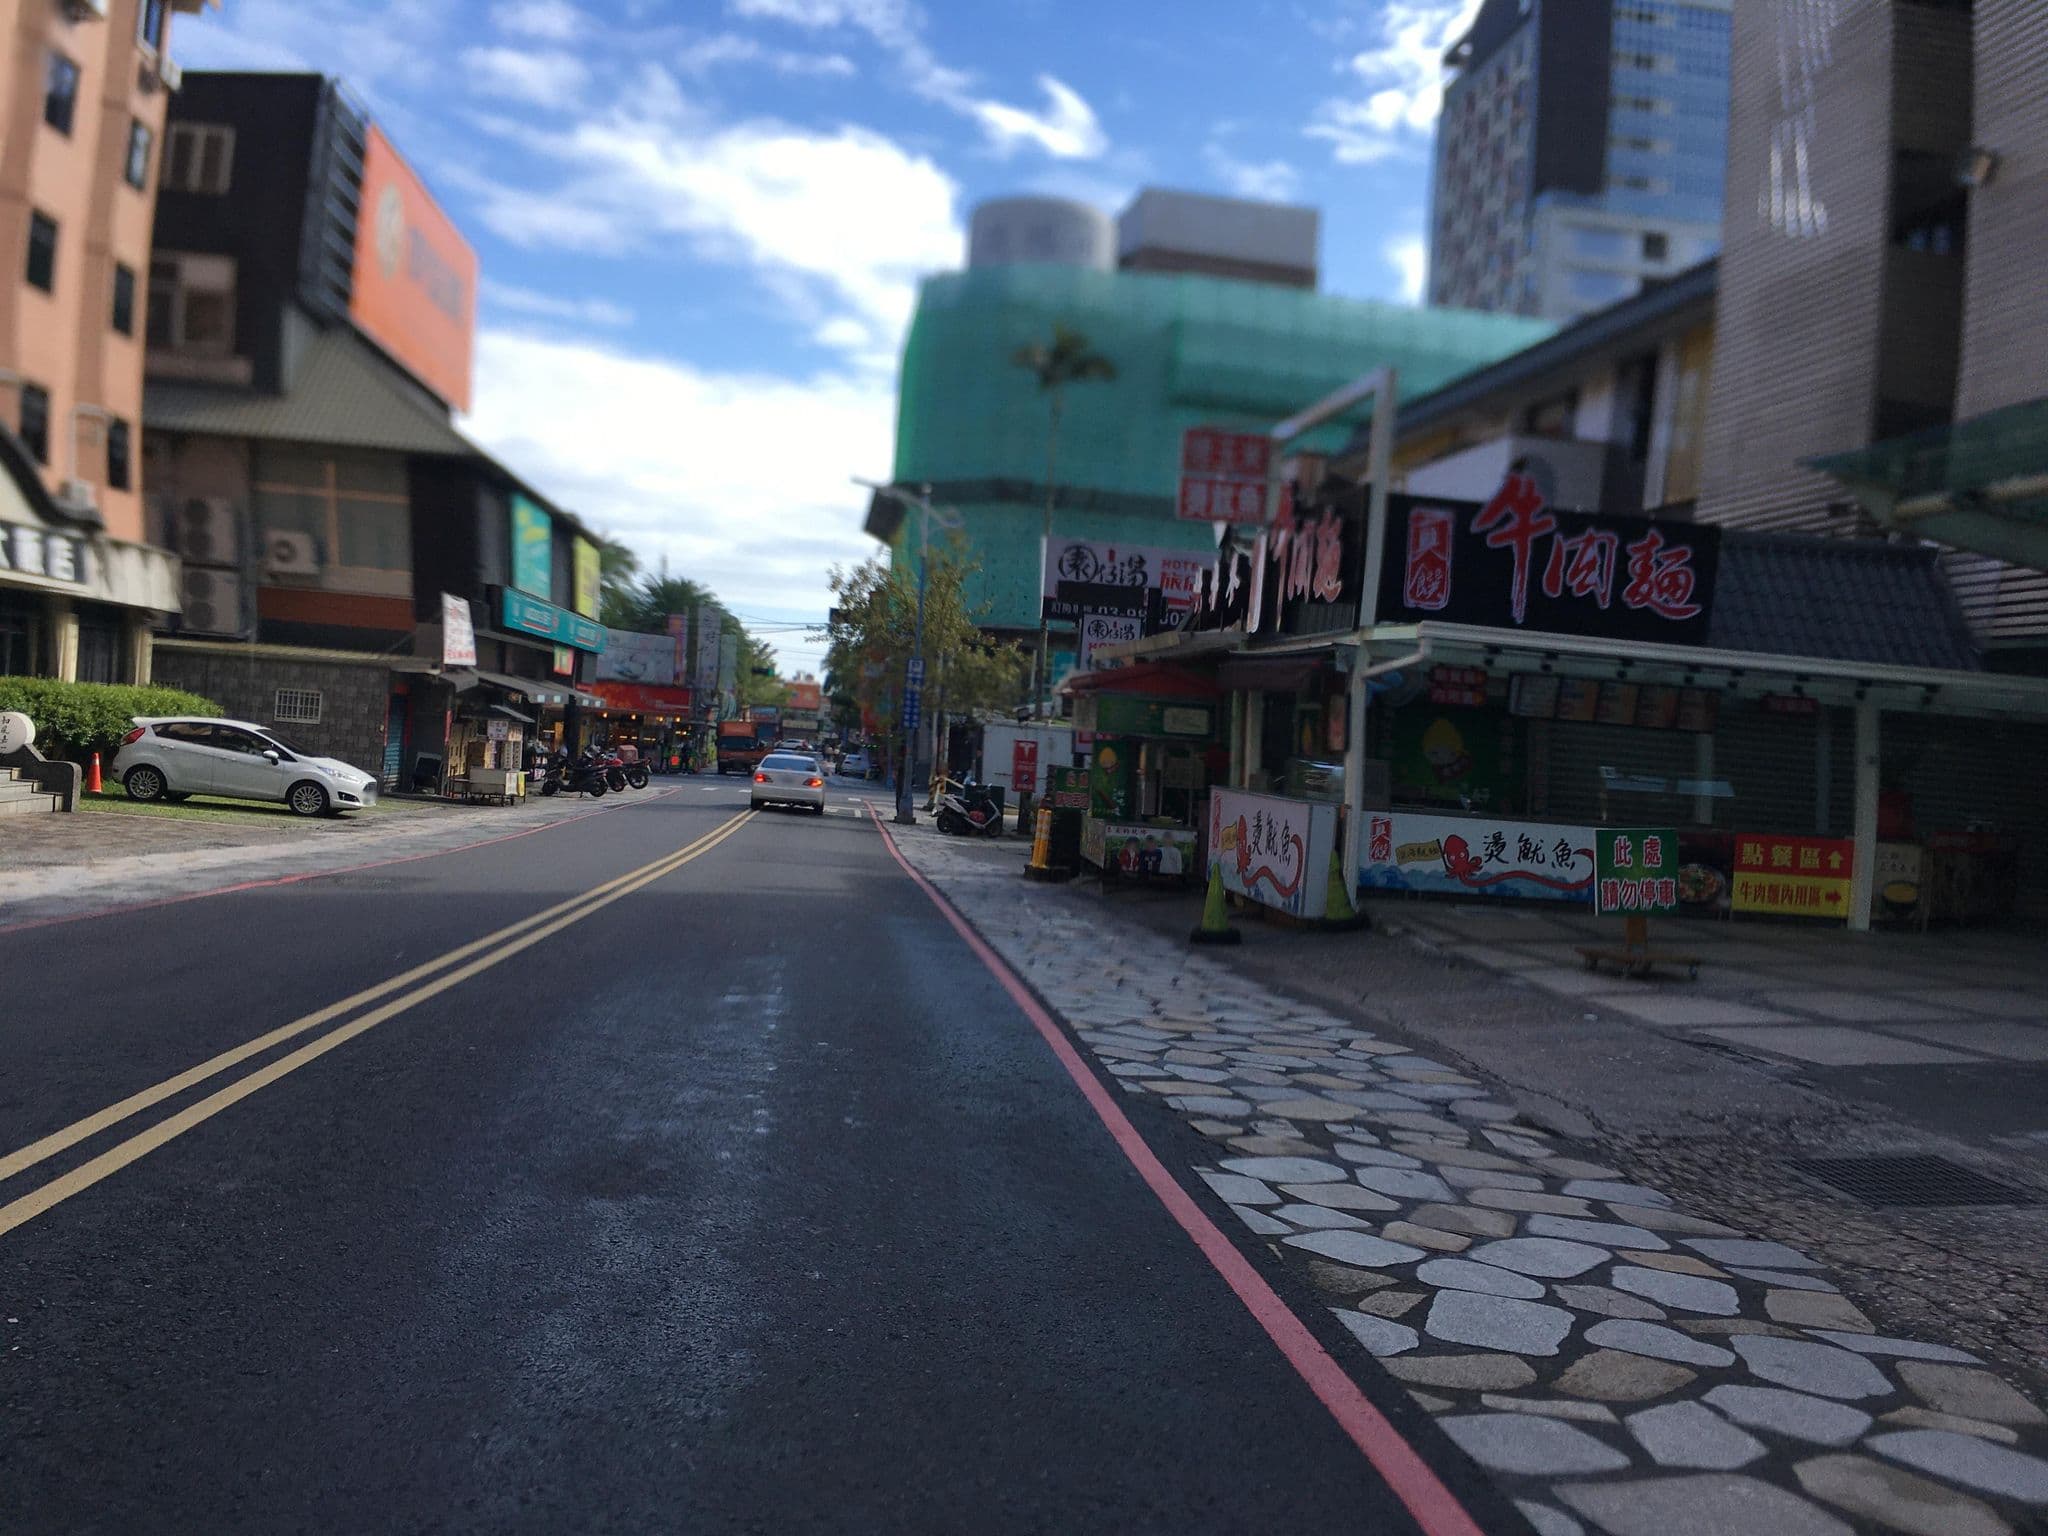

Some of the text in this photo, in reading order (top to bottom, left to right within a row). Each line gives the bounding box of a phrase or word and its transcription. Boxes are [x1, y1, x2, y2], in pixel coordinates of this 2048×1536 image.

[1470, 472, 1703, 623] 牛肉麵
[1252, 809, 1292, 866] 燙魷魚
[1483, 831, 1576, 871] 燙魷魚
[1613, 836, 1663, 868] 此處
[1742, 842, 1821, 869] 點餐區
[1601, 878, 1677, 909] 請勿停車
